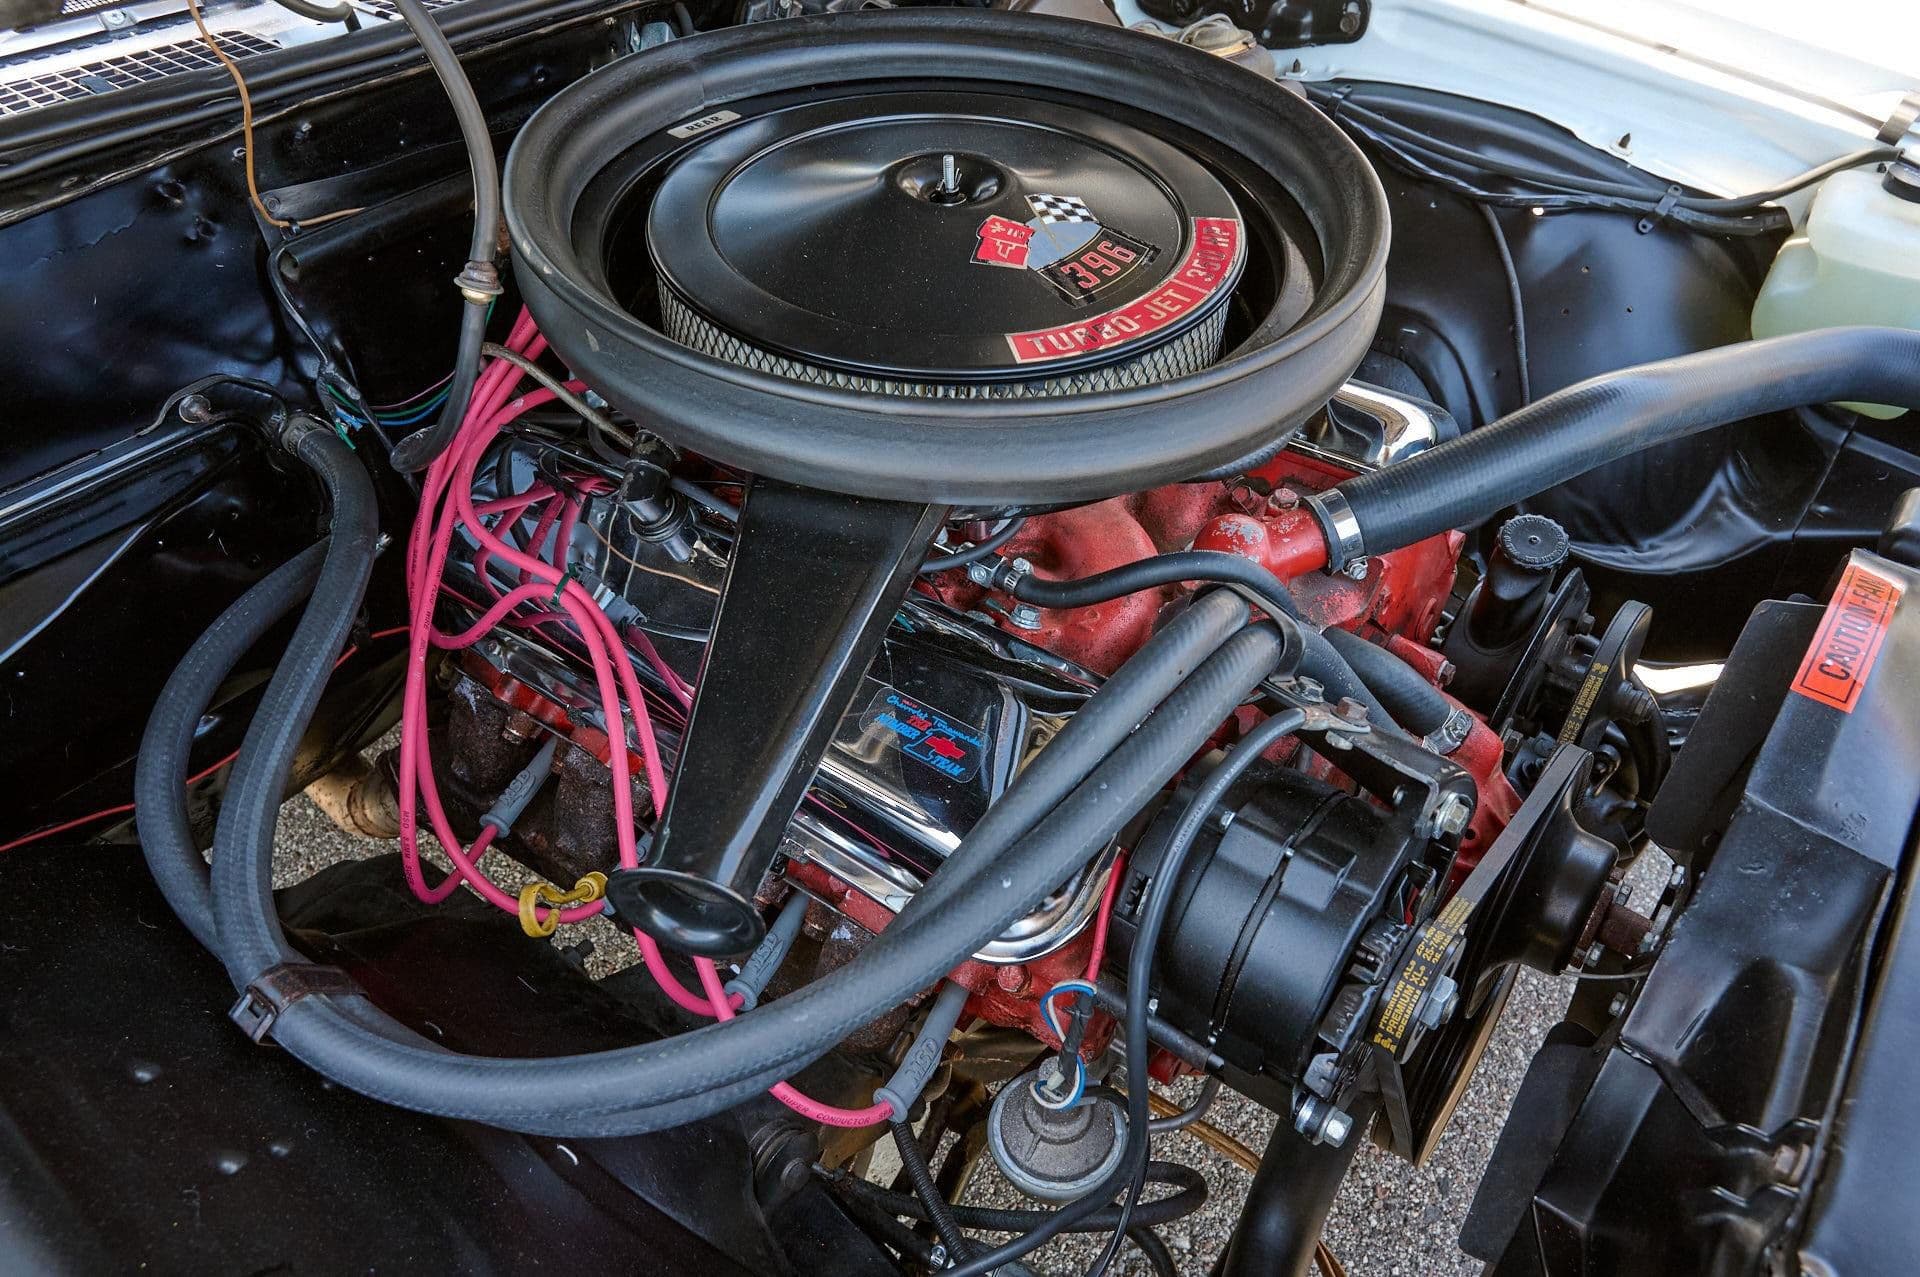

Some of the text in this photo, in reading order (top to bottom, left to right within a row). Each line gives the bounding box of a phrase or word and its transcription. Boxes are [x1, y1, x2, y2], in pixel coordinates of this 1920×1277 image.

[685, 116, 722, 131] REAR
[1062, 240, 1136, 289] 396
[1026, 288, 1191, 354] TURBO-JET
[1386, 984, 1415, 1035] PREMIUM
[780, 1094, 810, 1114] SUPER
[816, 1112, 871, 1125] CONDUCTOR
